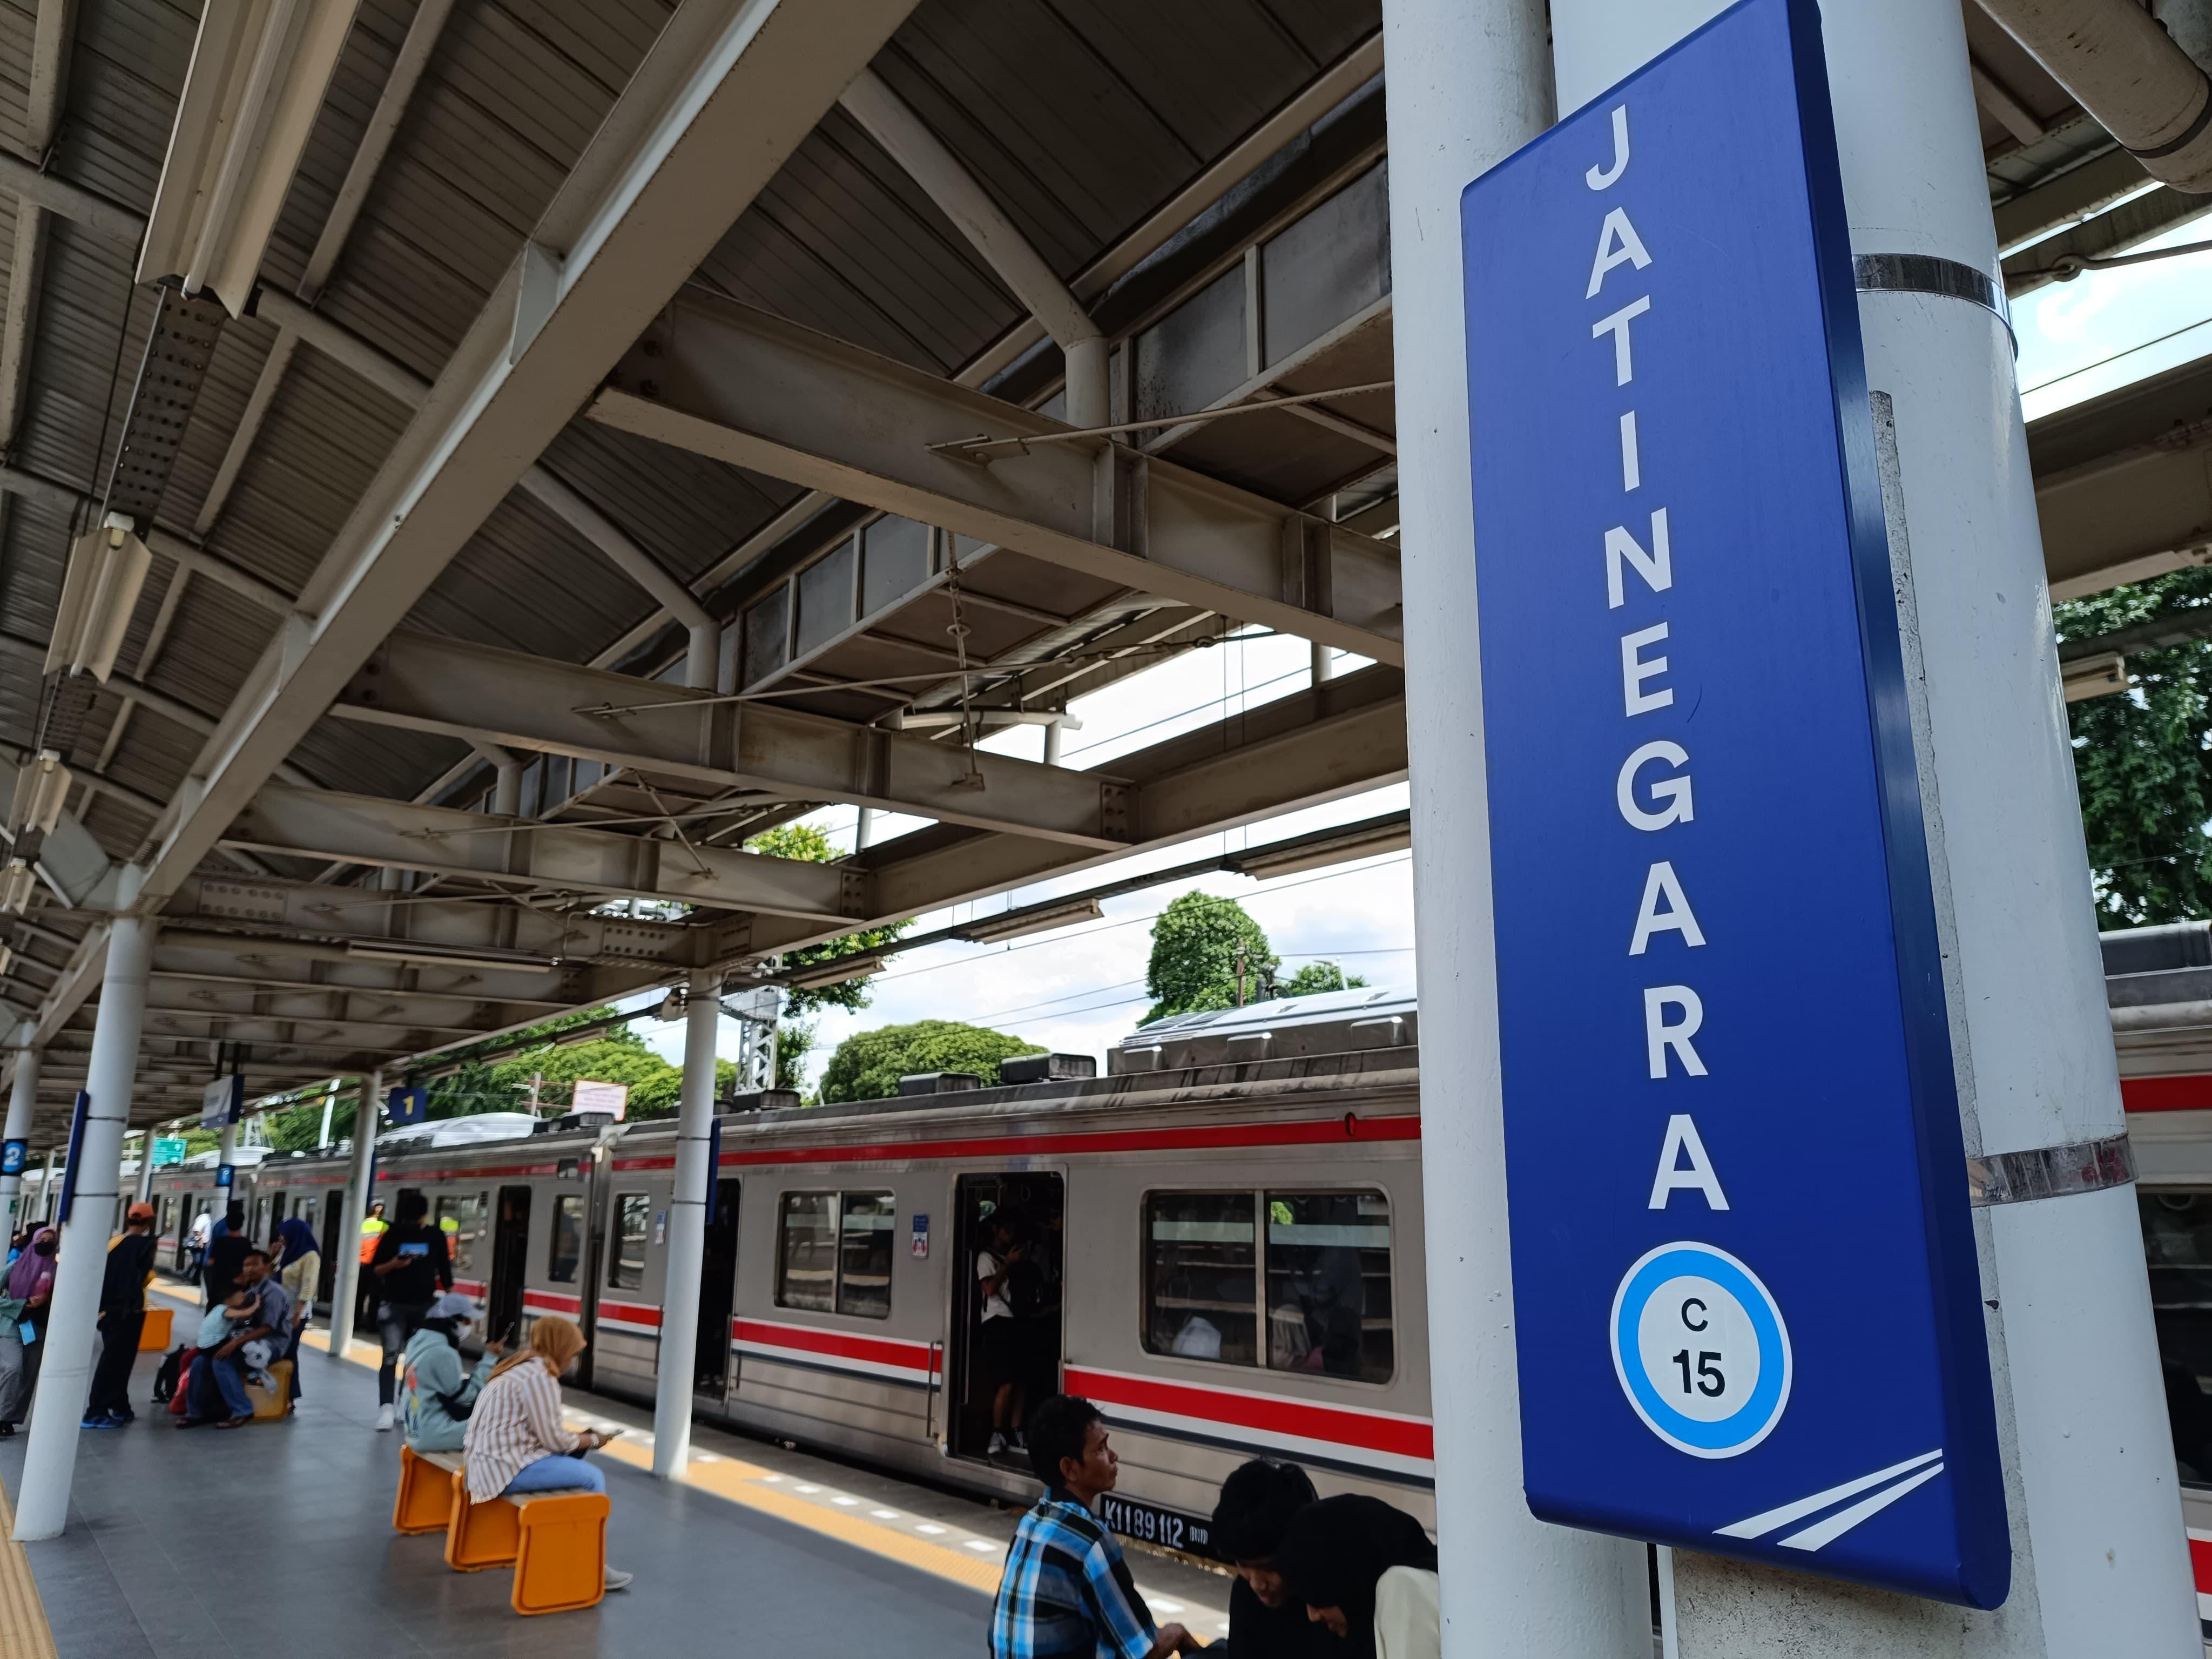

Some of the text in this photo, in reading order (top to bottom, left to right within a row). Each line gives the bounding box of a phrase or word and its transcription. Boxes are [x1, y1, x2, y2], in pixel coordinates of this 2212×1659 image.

[1585, 103, 1730, 1211] JATINEGARA
[402, 1095, 415, 1116] 1
[4, 1146, 20, 1166] 2
[1680, 1298, 1709, 1332] C
[1672, 1349, 1726, 1397] 15
